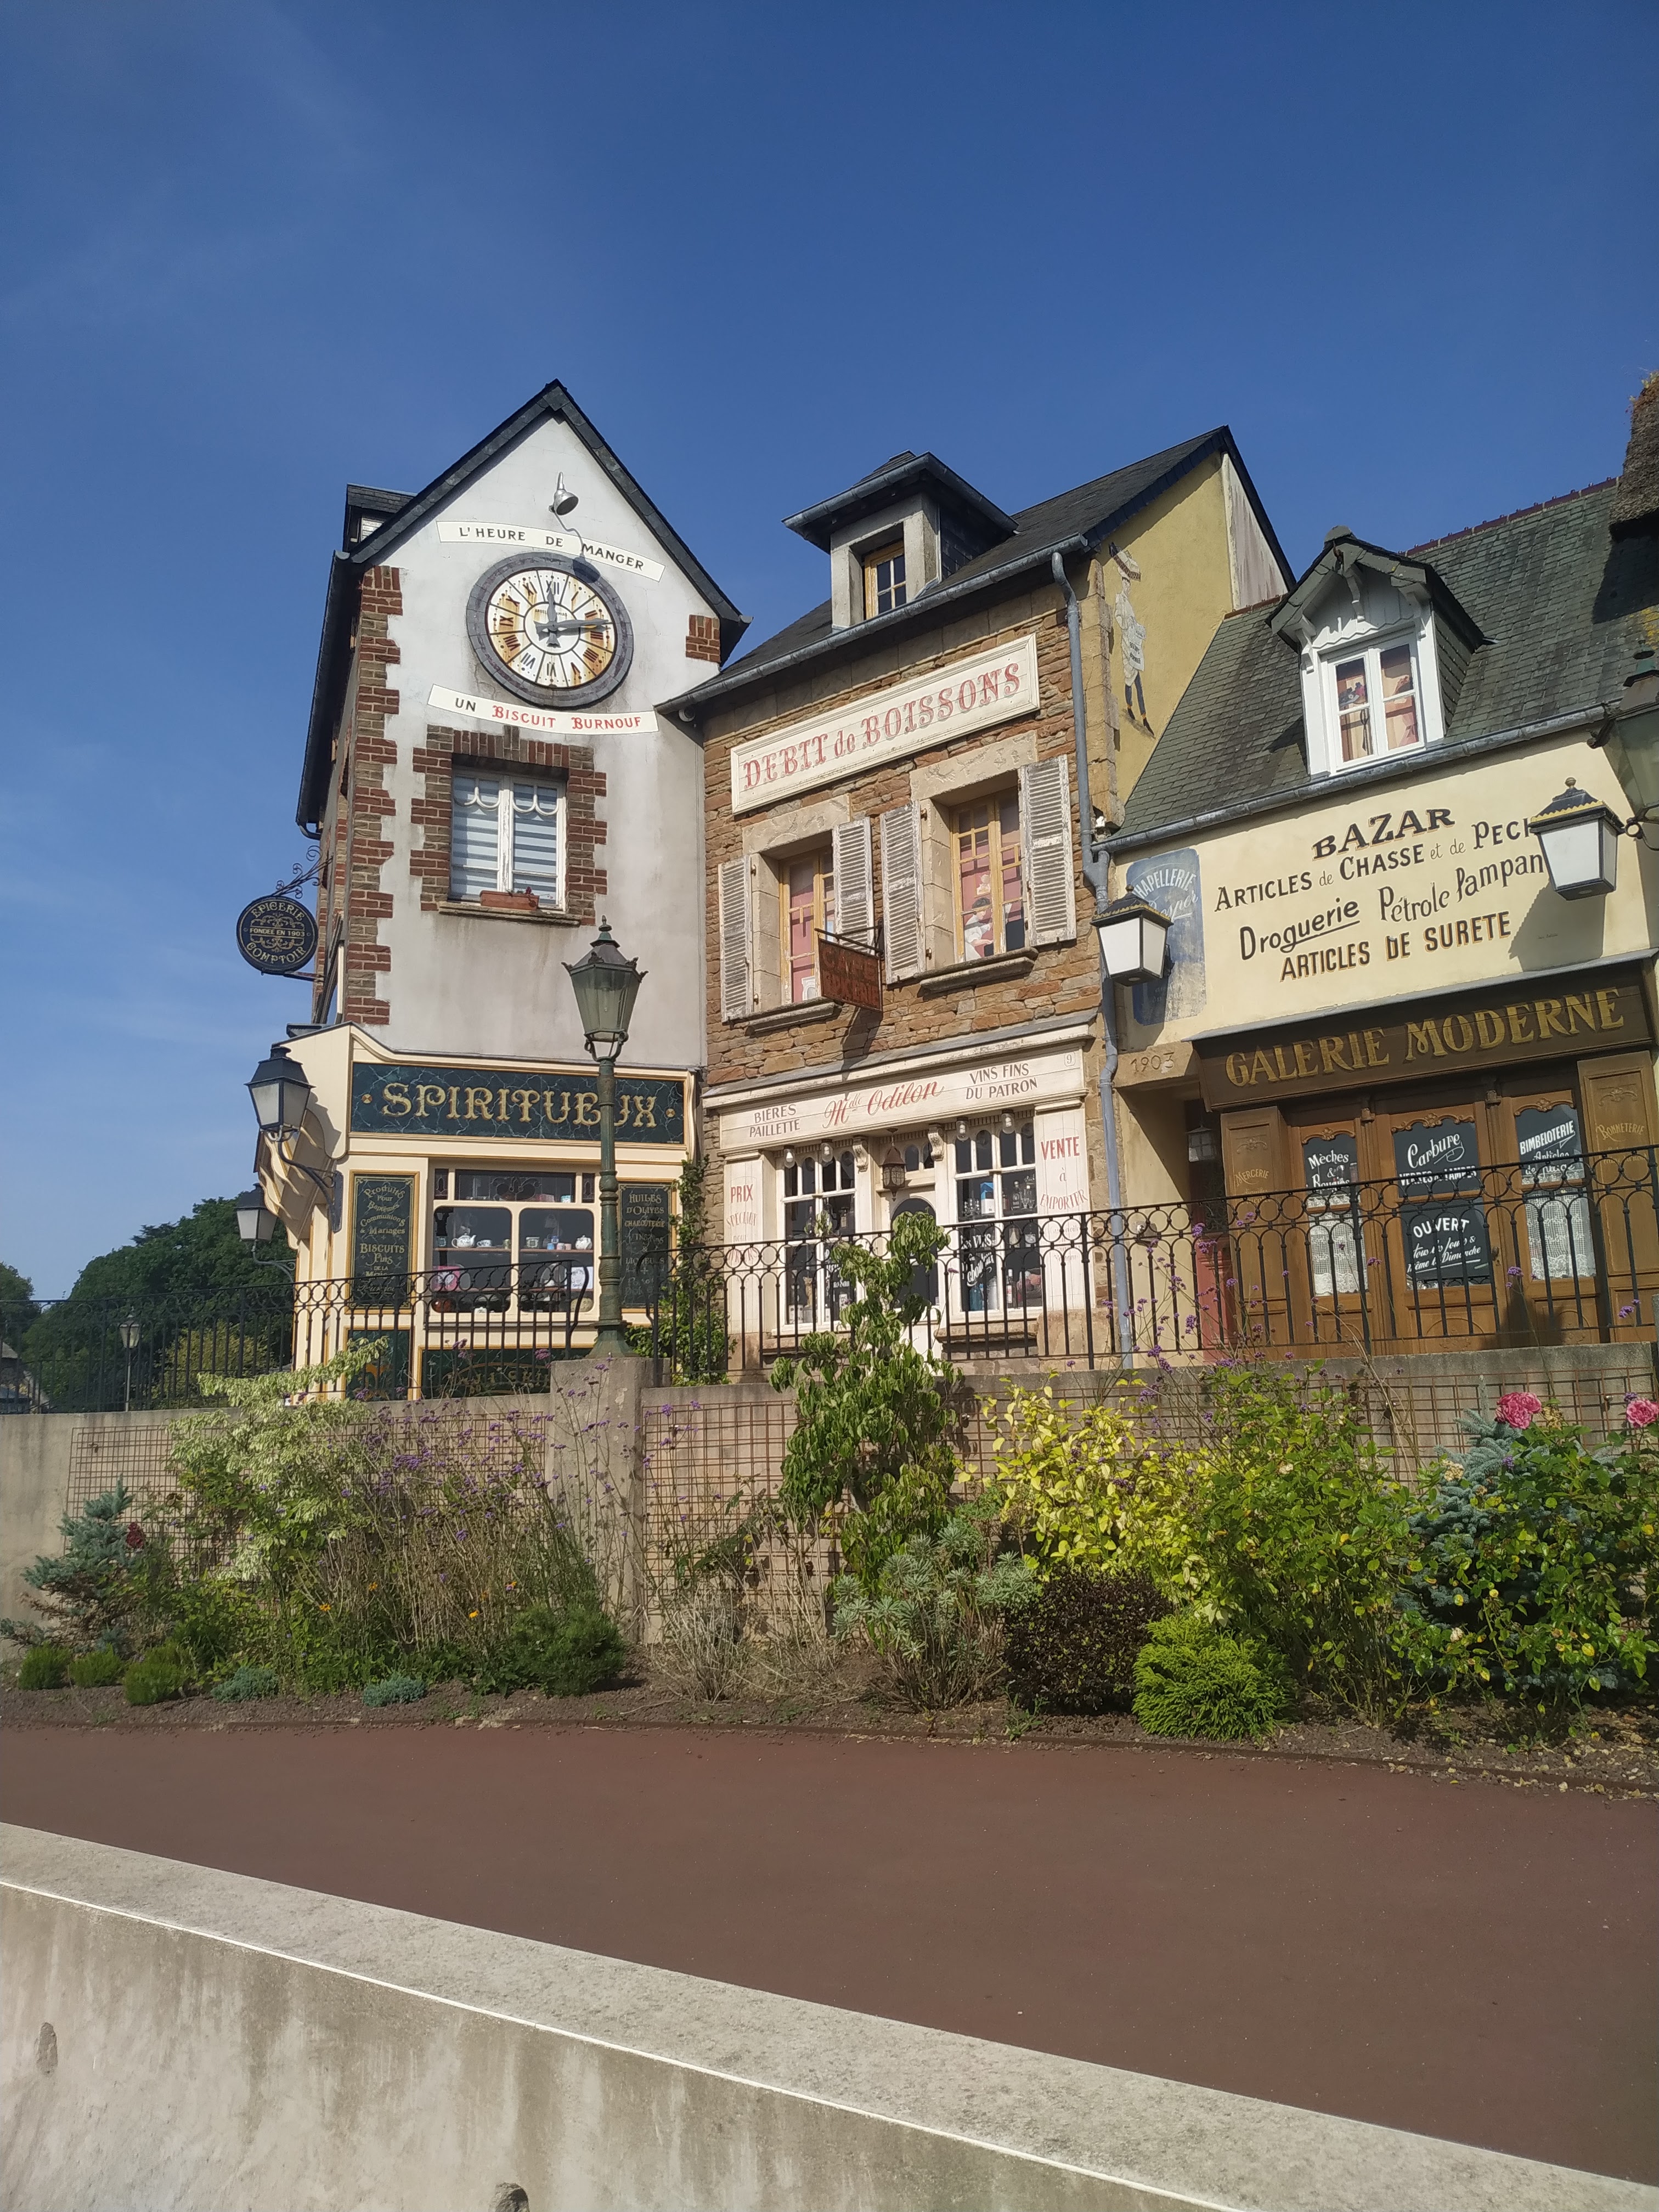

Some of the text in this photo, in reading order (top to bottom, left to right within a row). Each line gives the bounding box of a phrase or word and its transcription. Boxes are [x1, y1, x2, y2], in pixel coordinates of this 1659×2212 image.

[459, 527, 644, 571] L'HEURE DE MANGER
[455, 698, 641, 730] UN BISCUIT BURNOUF
[744, 663, 1020, 790] DEBIT de BOISSONS
[1311, 809, 1455, 861] BAZAR
[1214, 872, 1312, 912] ARTICLES
[1319, 870, 1334, 886] de
[1340, 843, 1425, 881] CHASSE
[1430, 843, 1443, 860] et
[1449, 838, 1466, 855] de
[251, 901, 304, 921] EPICERIE
[1240, 854, 1544, 961] Droguerie Pétrole lampan
[247, 942, 307, 964] COMPTOIR
[1280, 911, 1511, 983] ARTICLES DE SURETE
[1226, 988, 1624, 1086] GALERIE MODERNE
[1131, 1051, 1174, 1074] 1903
[867, 1081, 945, 1116] Odilon
[969, 1066, 998, 1085] VINS
[1003, 1063, 1029, 1078] FINS
[1066, 1054, 1072, 1064] 9
[749, 1077, 1037, 1138] PAILLETTE DU PATRON
[1519, 1120, 1575, 1155] BIMBELOTERIE
[1595, 1122, 1645, 1141] BONNETERIE
[1040, 1136, 1080, 1160] VENTE
[1408, 1133, 1460, 1169] Carbure
[1308, 1149, 1350, 1170] Mèches
[1059, 1167, 1067, 1182] à
[1234, 1169, 1269, 1187] MERCERIE
[1327, 1167, 1336, 1178] &
[364, 1184, 405, 1199] Produits
[629, 1193, 662, 1204] HUILES
[731, 1183, 754, 1204] PRIX
[360, 1214, 406, 1227] Communions
[369, 1226, 405, 1235] Mariages
[1413, 1217, 1470, 1238] OUVERT
[359, 1243, 405, 1254] BISCUITS
[1441, 1237, 1468, 1258] Jous
[1469, 1235, 1476, 1244] &
[365, 1252, 393, 1266] Fins
[625, 1257, 665, 1266] LIQEUS
